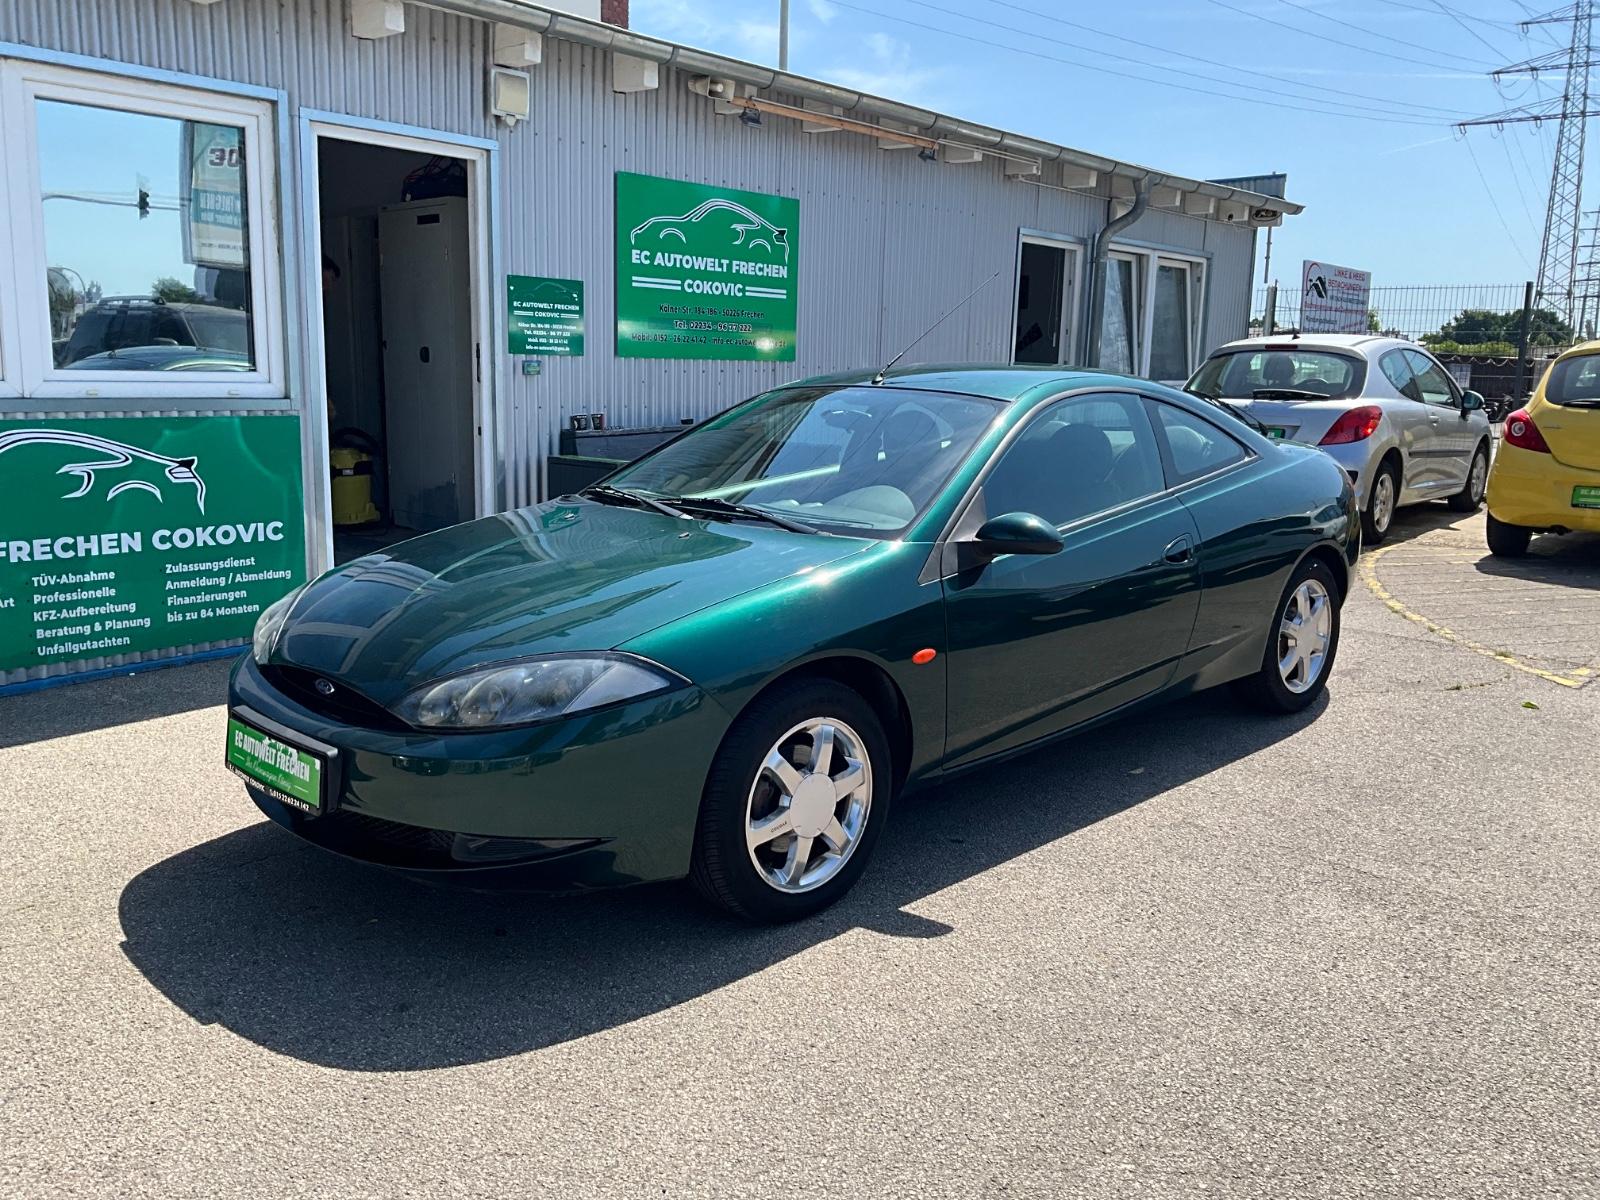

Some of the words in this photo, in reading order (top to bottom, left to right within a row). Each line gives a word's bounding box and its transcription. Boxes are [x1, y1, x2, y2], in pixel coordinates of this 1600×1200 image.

[631, 249, 651, 265] EC
[654, 252, 729, 273] AUTOWELT
[732, 260, 788, 279] FRECHEN
[683, 279, 743, 297] COKOVIC
[522, 301, 554, 310] AUTOWELT
[554, 303, 579, 311] FRECHEN
[741, 309, 765, 319] Frechen
[674, 320, 687, 329] Tel.
[689, 321, 712, 331] 02234
[152, 521, 284, 551] COKOVIC
[165, 557, 256, 574] Zulassungsdienst
[32, 571, 115, 587] TÜV-Abnahme
[165, 576, 226, 590] Anmeldung
[235, 569, 291, 583] Abmeldung
[33, 587, 116, 604] Professionelle
[167, 590, 247, 606] Finanzierungen
[33, 602, 136, 622] KFZ-Aufbereitung
[167, 611, 183, 622] bis
[185, 611, 198, 620] zu
[200, 608, 213, 618] 84
[216, 604, 259, 616] Monaten
[36, 624, 91, 639] Beratung
[94, 622, 102, 632] &
[105, 617, 151, 631] Planung
[37, 636, 130, 656] Unfallgutachten
[235, 729, 244, 748] EC
[243, 734, 277, 765] AUTOWELT
[276, 751, 310, 782] FRECHEN
